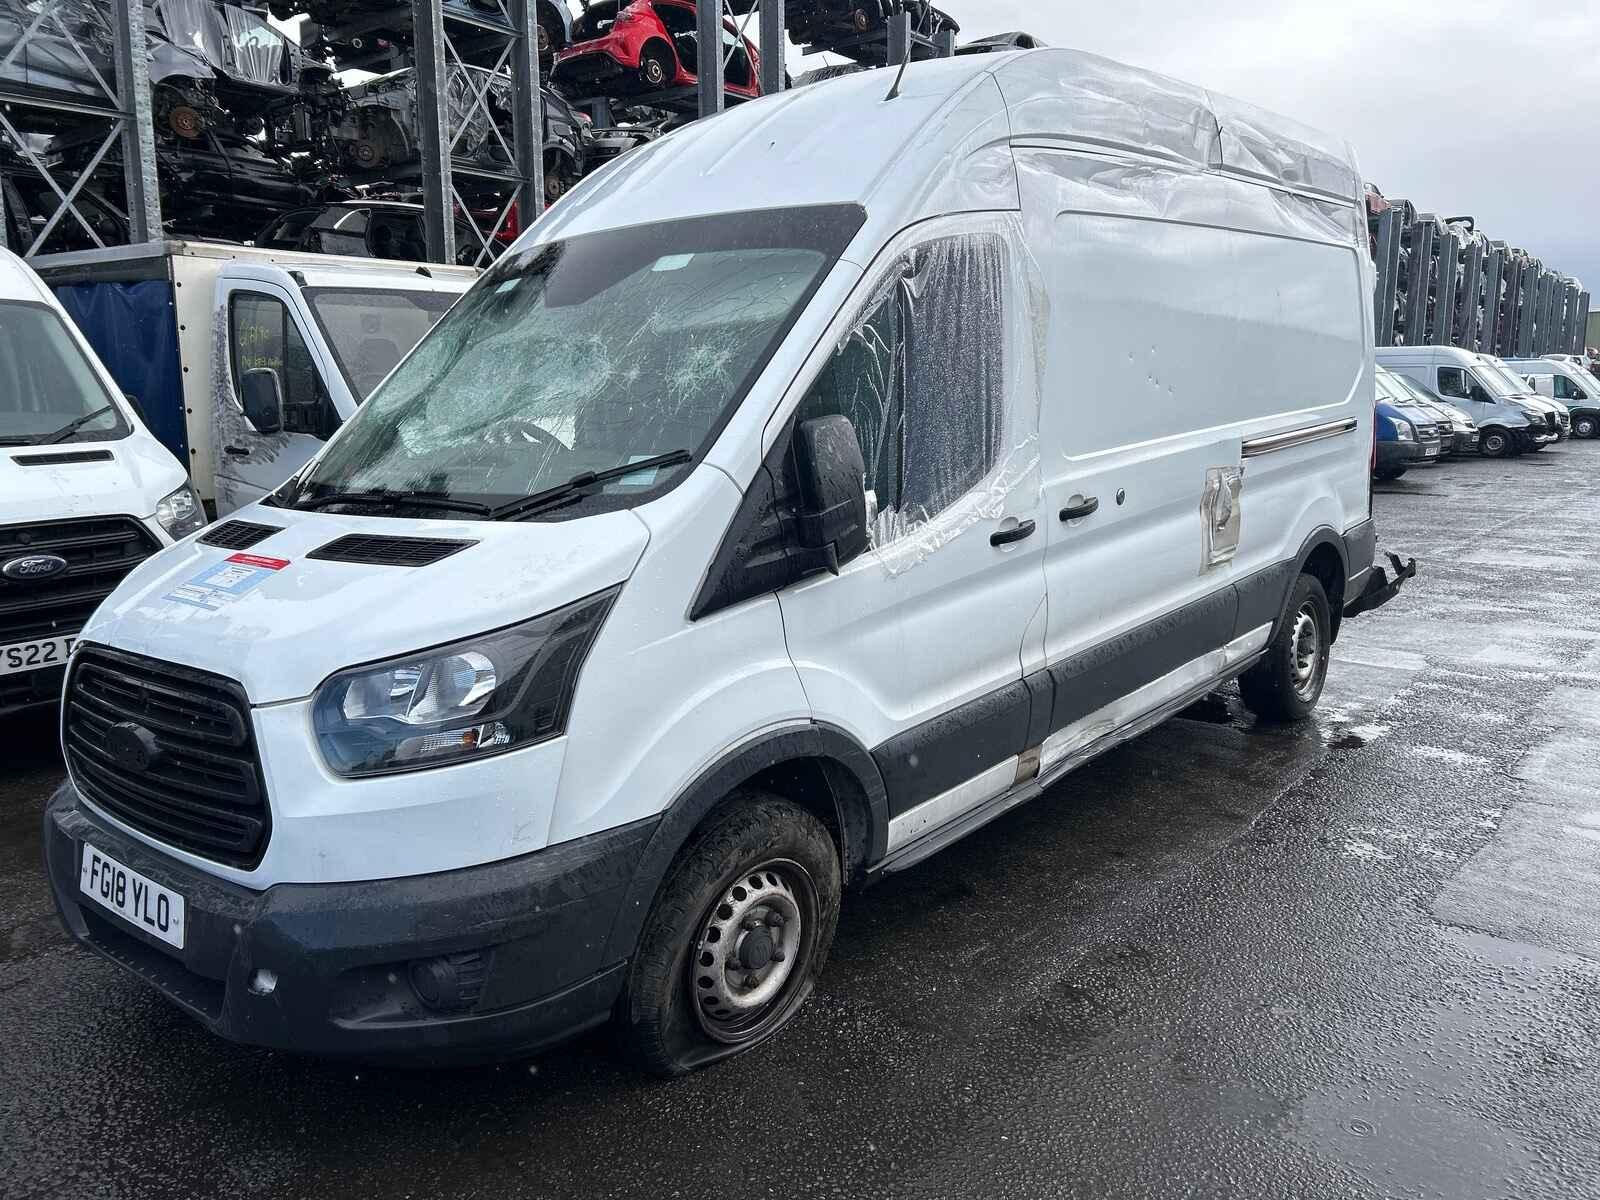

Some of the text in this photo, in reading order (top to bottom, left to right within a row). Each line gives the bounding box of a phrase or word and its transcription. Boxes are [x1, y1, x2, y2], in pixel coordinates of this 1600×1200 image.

[20, 559, 54, 574] Ford
[0, 641, 58, 668] S22
[90, 854, 170, 933] FG18 YLO
